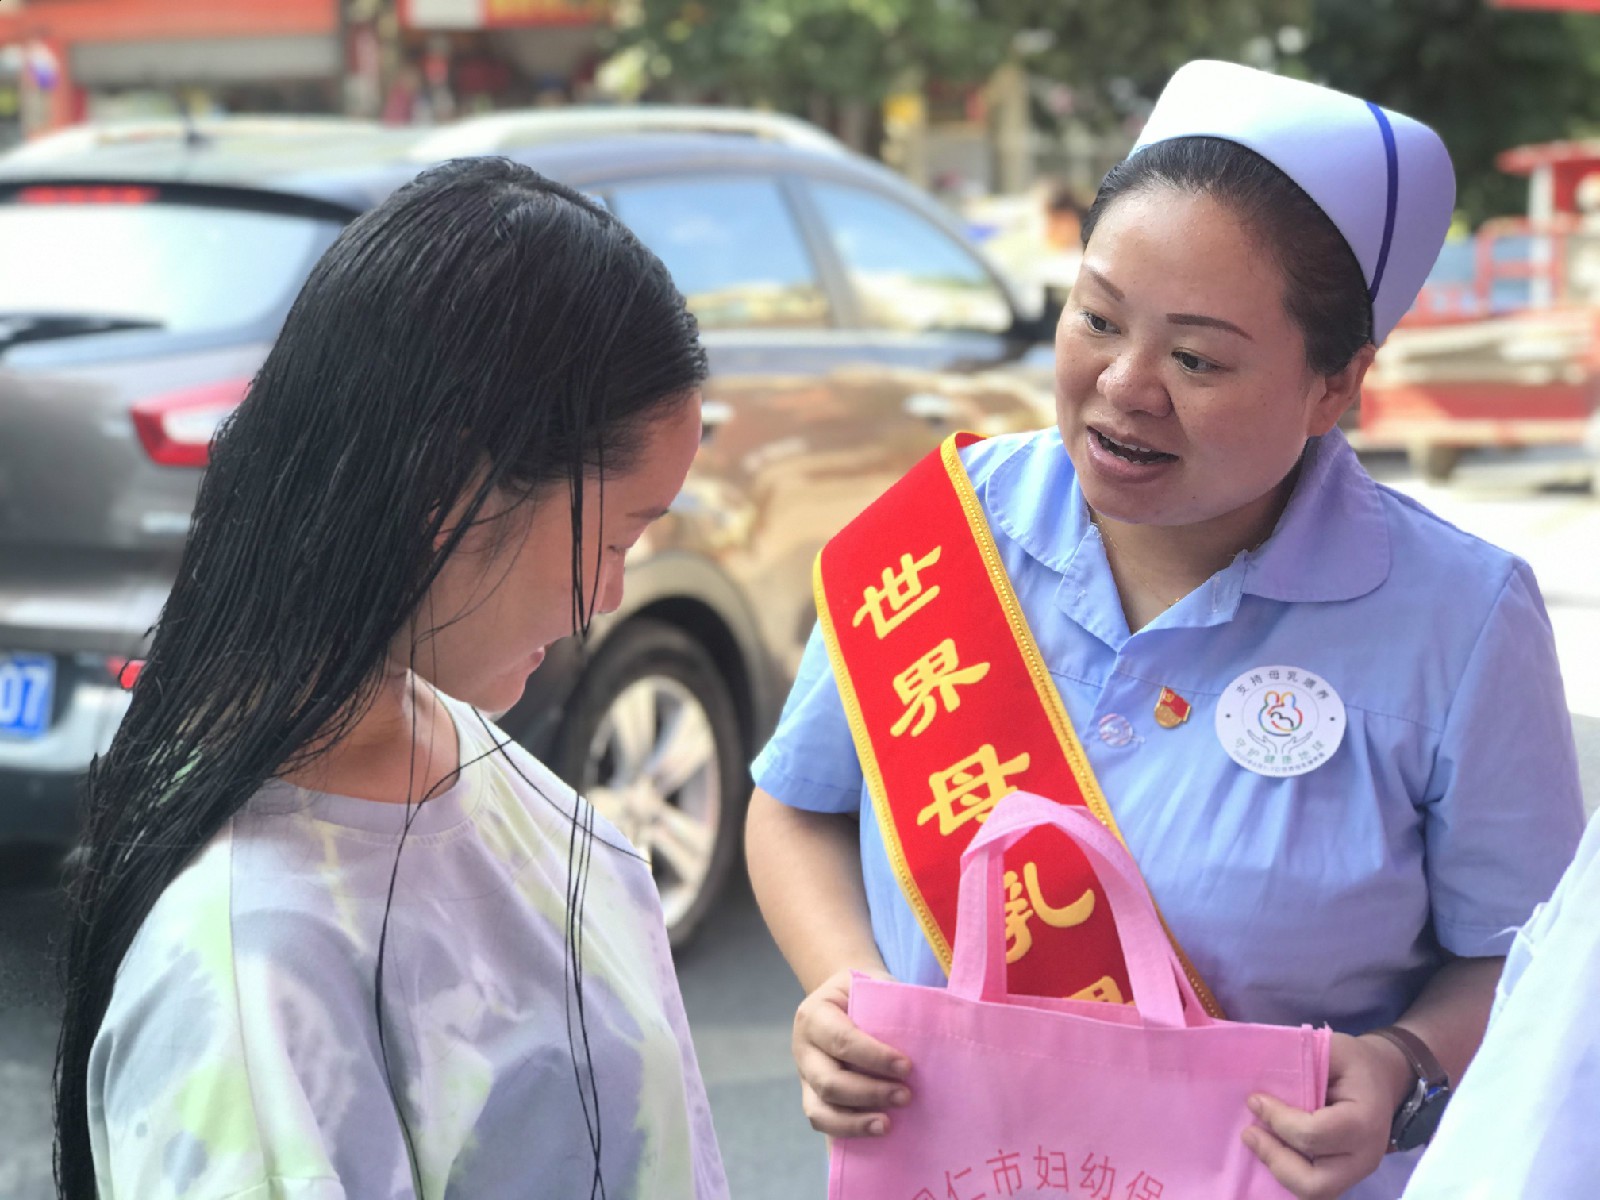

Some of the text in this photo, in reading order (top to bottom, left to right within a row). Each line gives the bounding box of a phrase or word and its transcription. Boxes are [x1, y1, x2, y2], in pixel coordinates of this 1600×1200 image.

[853, 545, 1136, 1006] 世界母乳
[912, 1145, 1164, 1200] 仁市妇幼保
